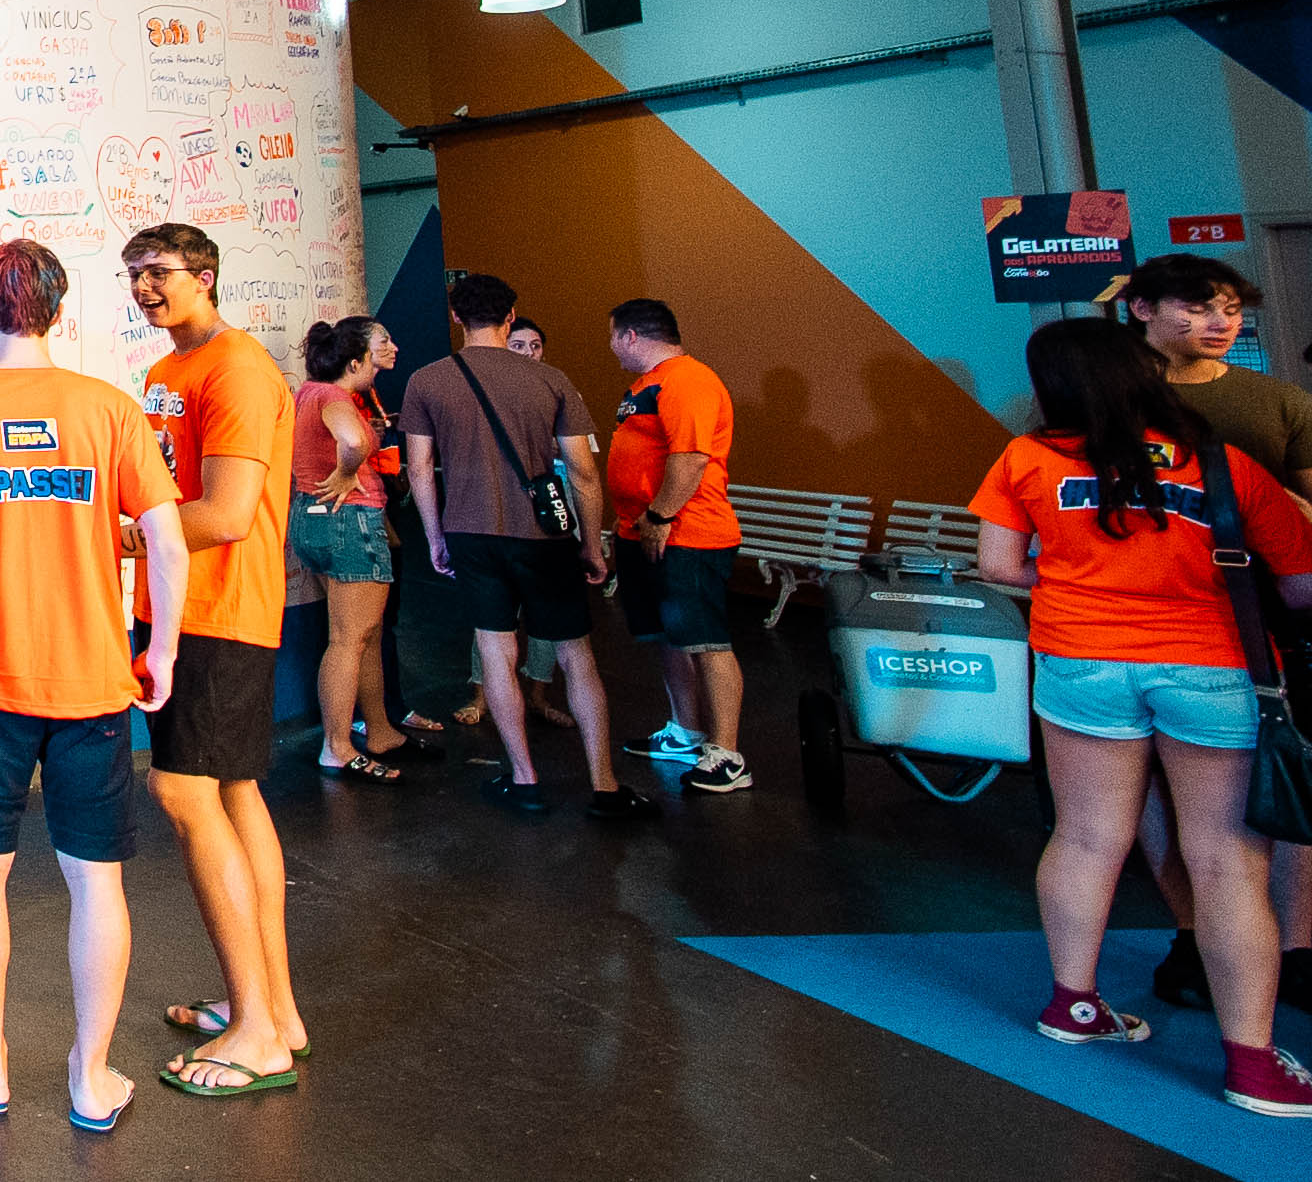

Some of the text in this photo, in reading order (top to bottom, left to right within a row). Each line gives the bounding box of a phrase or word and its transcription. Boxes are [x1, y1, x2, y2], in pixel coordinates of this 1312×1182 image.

[1002, 237, 1120, 255] GELATERIA
[8, 432, 52, 446] ETAPA
[878, 656, 983, 675] ICESHOP
